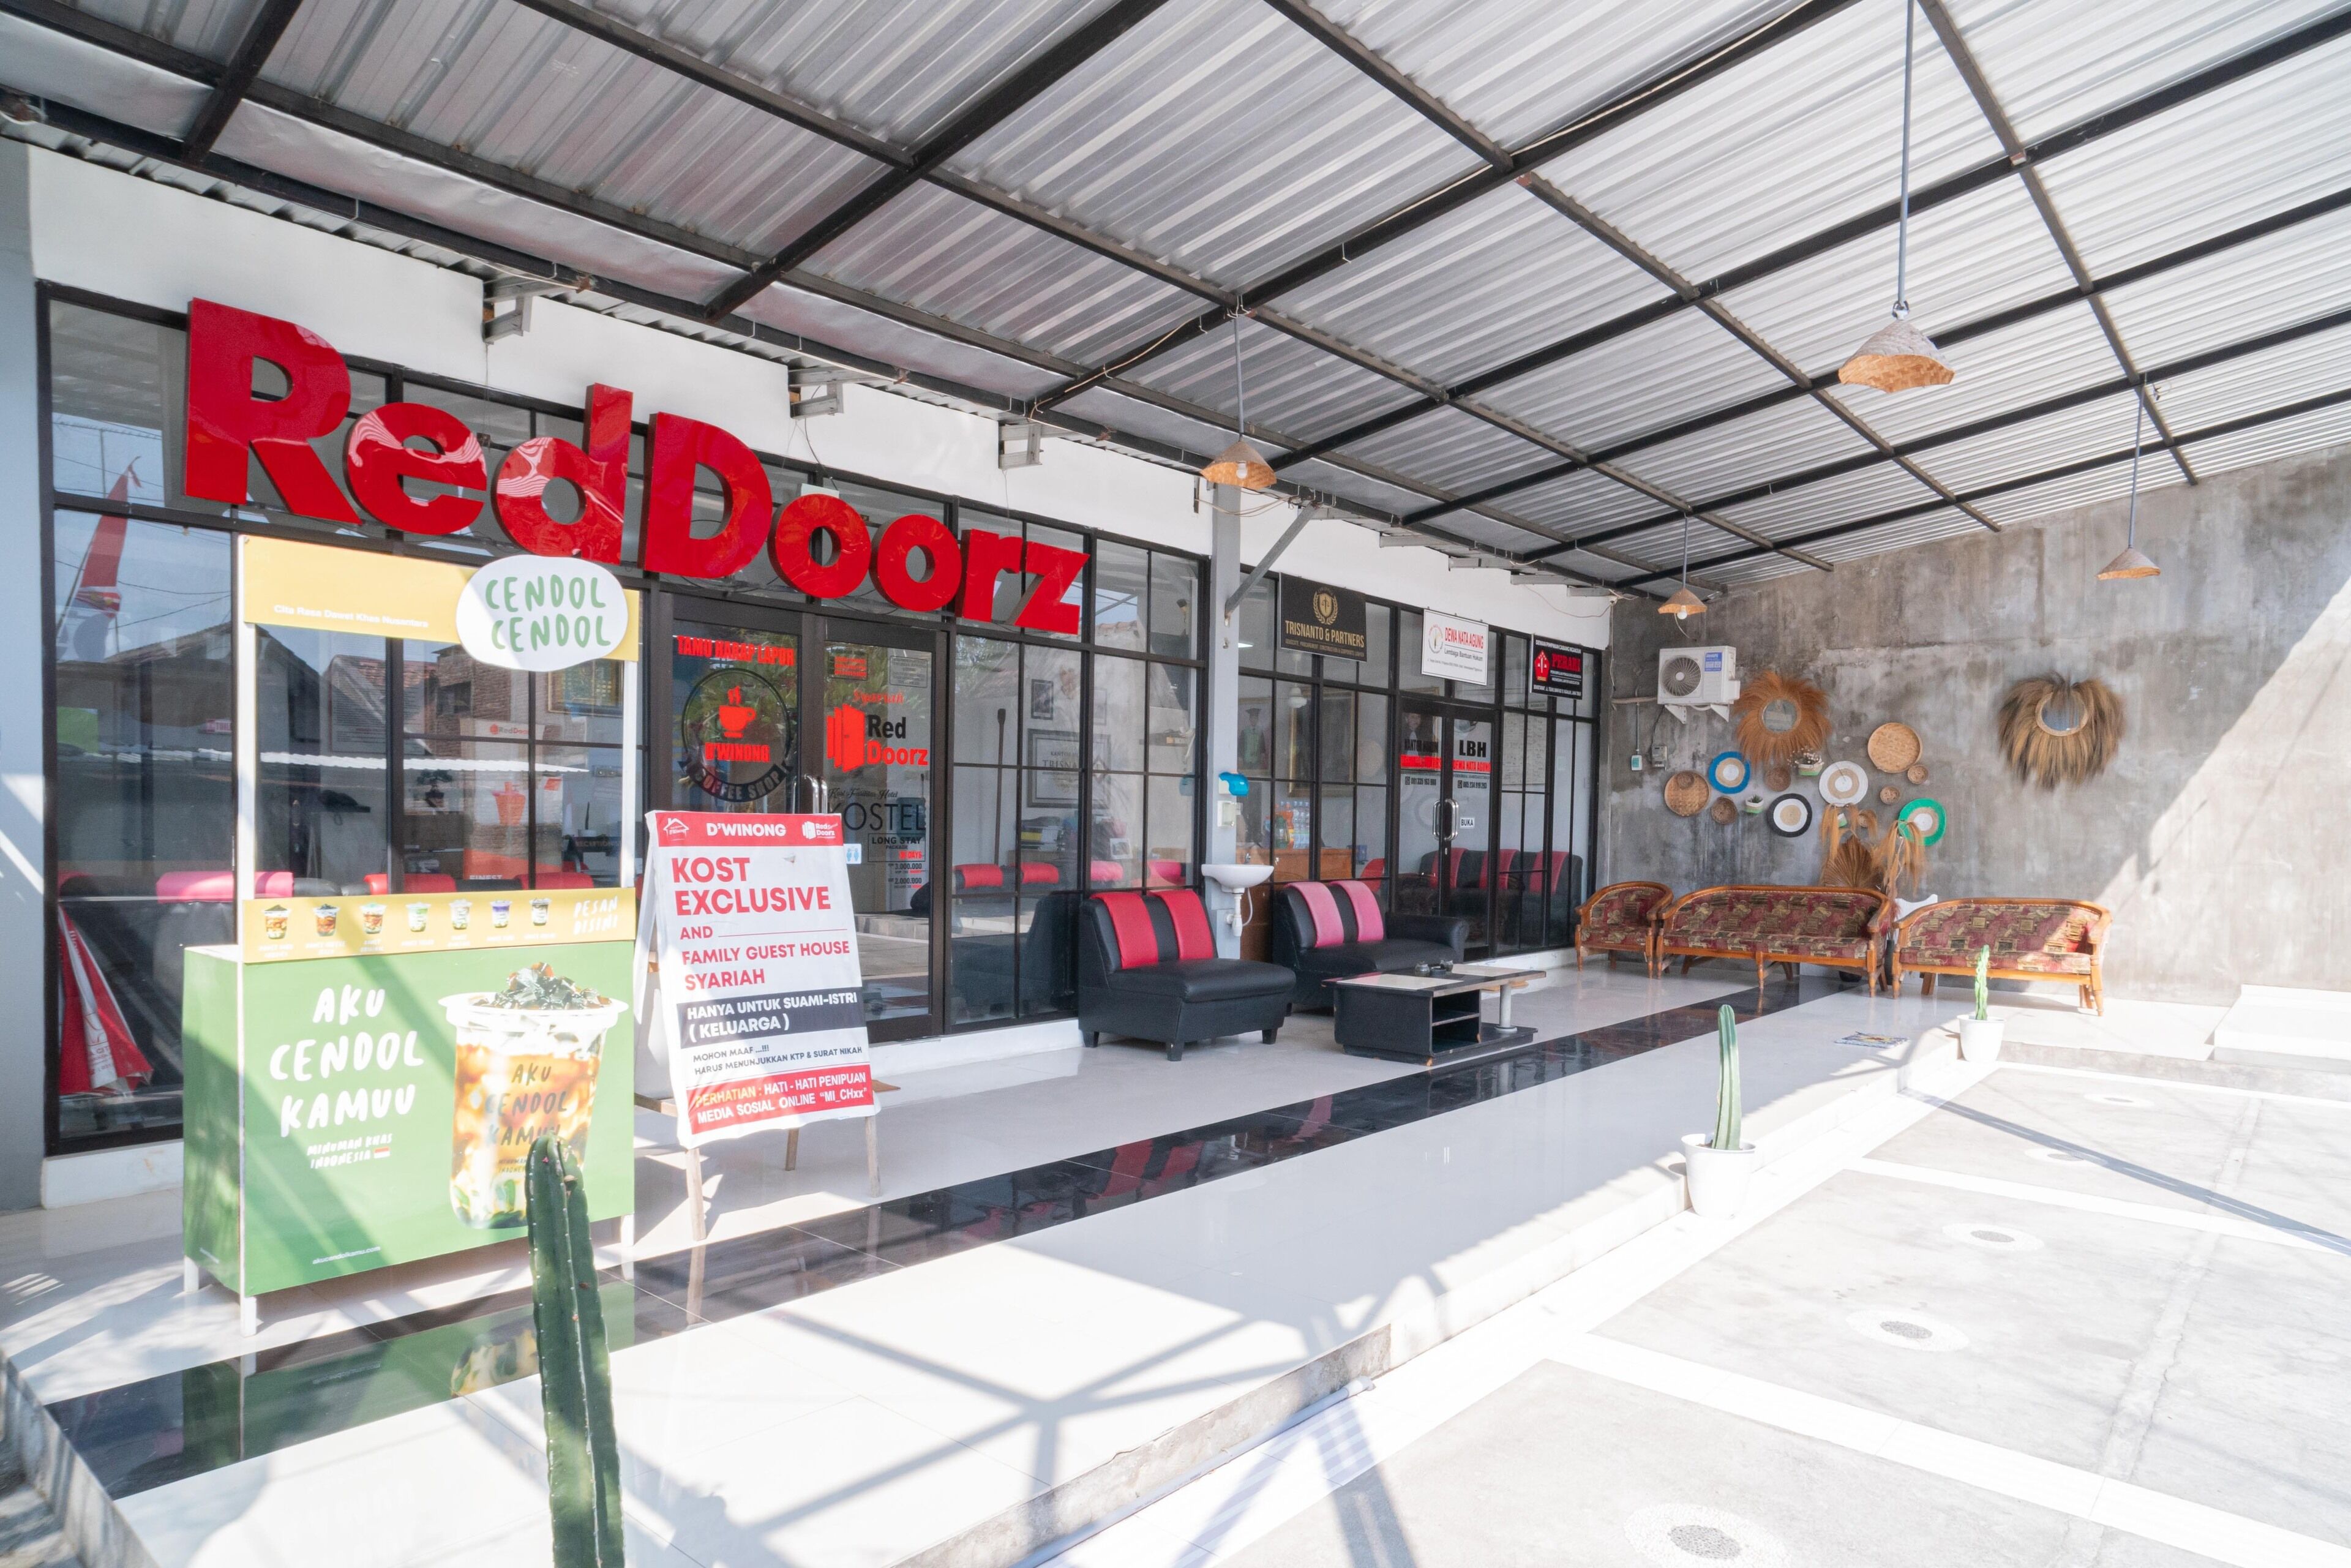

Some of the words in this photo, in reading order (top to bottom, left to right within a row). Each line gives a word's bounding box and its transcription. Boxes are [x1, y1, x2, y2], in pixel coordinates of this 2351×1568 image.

[186, 297, 1090, 636] RedDoorz
[485, 574, 606, 613] CENDOL
[297, 607, 322, 617] Rasa
[356, 613, 380, 623] Khas
[491, 615, 611, 652] CENDOL
[1285, 620, 1323, 640] TRISNANTO
[1325, 628, 1330, 641] &
[1331, 629, 1365, 648] PARTNERS
[1445, 627, 1457, 643] DEWA
[1458, 629, 1469, 645] NATA
[1469, 632, 1483, 649] AGUNG
[677, 635, 712, 658] TAMU
[714, 640, 756, 662] HARAP
[757, 645, 795, 667] LAPOR
[867, 715, 906, 739] Red
[705, 742, 770, 762] D'WINONG
[866, 740, 928, 766] Doorz
[1459, 740, 1487, 757] LBH
[694, 770, 742, 800] COFFEE
[747, 770, 781, 799] SHOP
[707, 823, 786, 836] D'WINONG
[907, 850, 922, 859] DAYS
[672, 857, 750, 882] KOST
[573, 895, 618, 918] PESAN
[675, 887, 831, 915] EXCLUSIVE
[572, 915, 618, 936] DISINI
[680, 926, 713, 940] AND
[682, 948, 741, 965] FAMILY
[746, 944, 795, 960] GUEST
[800, 941, 850, 956] HOUSE
[684, 969, 765, 991] SYARIAH
[312, 983, 386, 1026] AKU
[687, 1005, 735, 1021] HANYA
[737, 999, 781, 1014] UNTUK
[784, 992, 858, 1008] SUAMI-ISTRI
[689, 1025, 697, 1043] (
[699, 1016, 782, 1039] KELUARGA
[783, 1013, 790, 1030] )
[269, 1030, 426, 1082] CENDOL
[693, 1050, 727, 1062] MOHON
[730, 1046, 754, 1057] MAAF
[694, 1064, 723, 1075] HARUS
[726, 1054, 788, 1070] MENUNJUKKAN
[790, 1052, 805, 1061] KTP
[813, 1049, 838, 1058] SURAT
[840, 1046, 863, 1055] NIKAH
[512, 1063, 552, 1086] AKU
[696, 1086, 757, 1108] PERHATIAN
[764, 1082, 788, 1095] HATI
[795, 1077, 817, 1090] HATI
[819, 1072, 866, 1087] PENIPUAN
[280, 1084, 416, 1137] KAMUU
[485, 1091, 568, 1117] CENDOL
[697, 1108, 734, 1124] MEDIA
[737, 1102, 774, 1117] SOSIAL
[780, 1095, 816, 1109] ONLINE
[307, 1137, 362, 1156] MINUMAN
[366, 1133, 392, 1147] KHAS
[310, 1149, 371, 1169] INDONESIA
